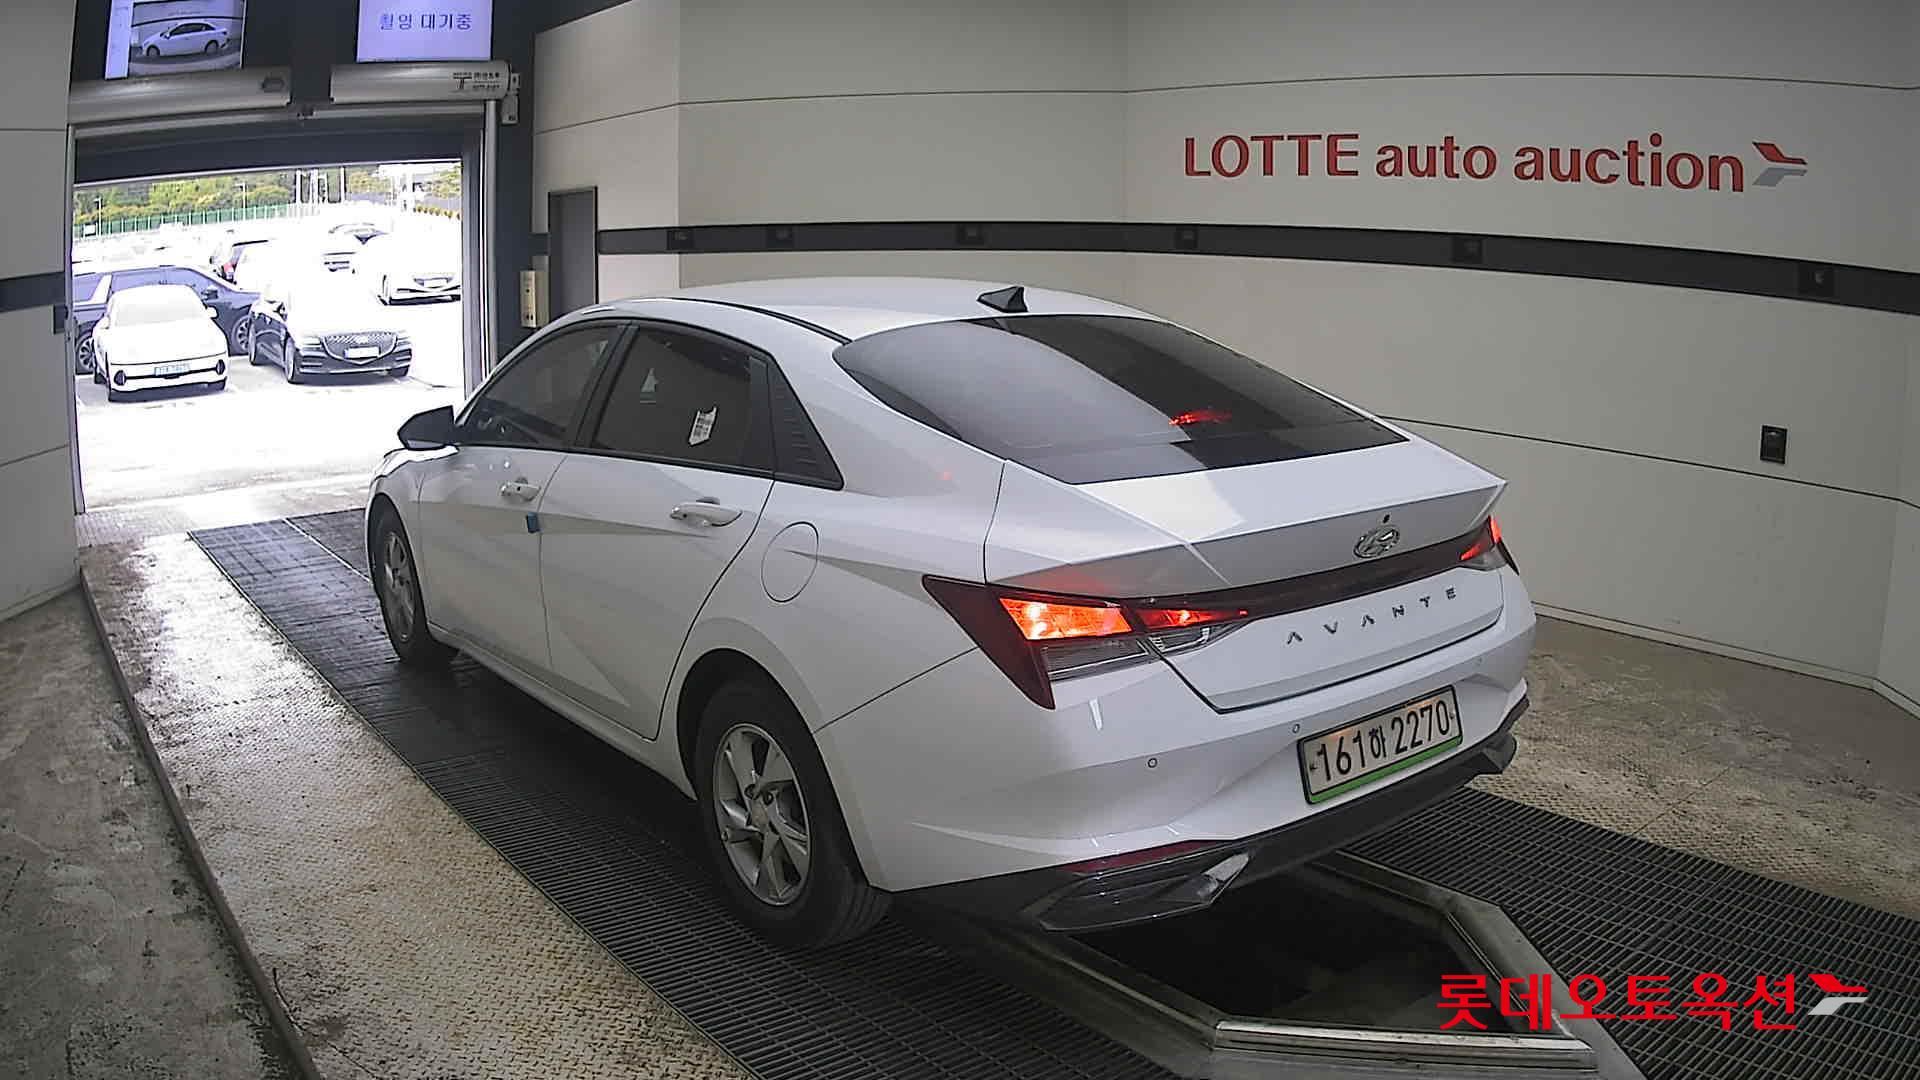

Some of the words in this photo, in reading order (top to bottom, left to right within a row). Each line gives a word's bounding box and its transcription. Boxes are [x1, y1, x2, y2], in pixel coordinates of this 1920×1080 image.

[421, 13, 472, 31] 대기중
[1185, 134, 1360, 177] LOTTE
[1376, 136, 1498, 179] auto
[1514, 133, 1744, 192] auction
[1286, 587, 1457, 645] AVANTE
